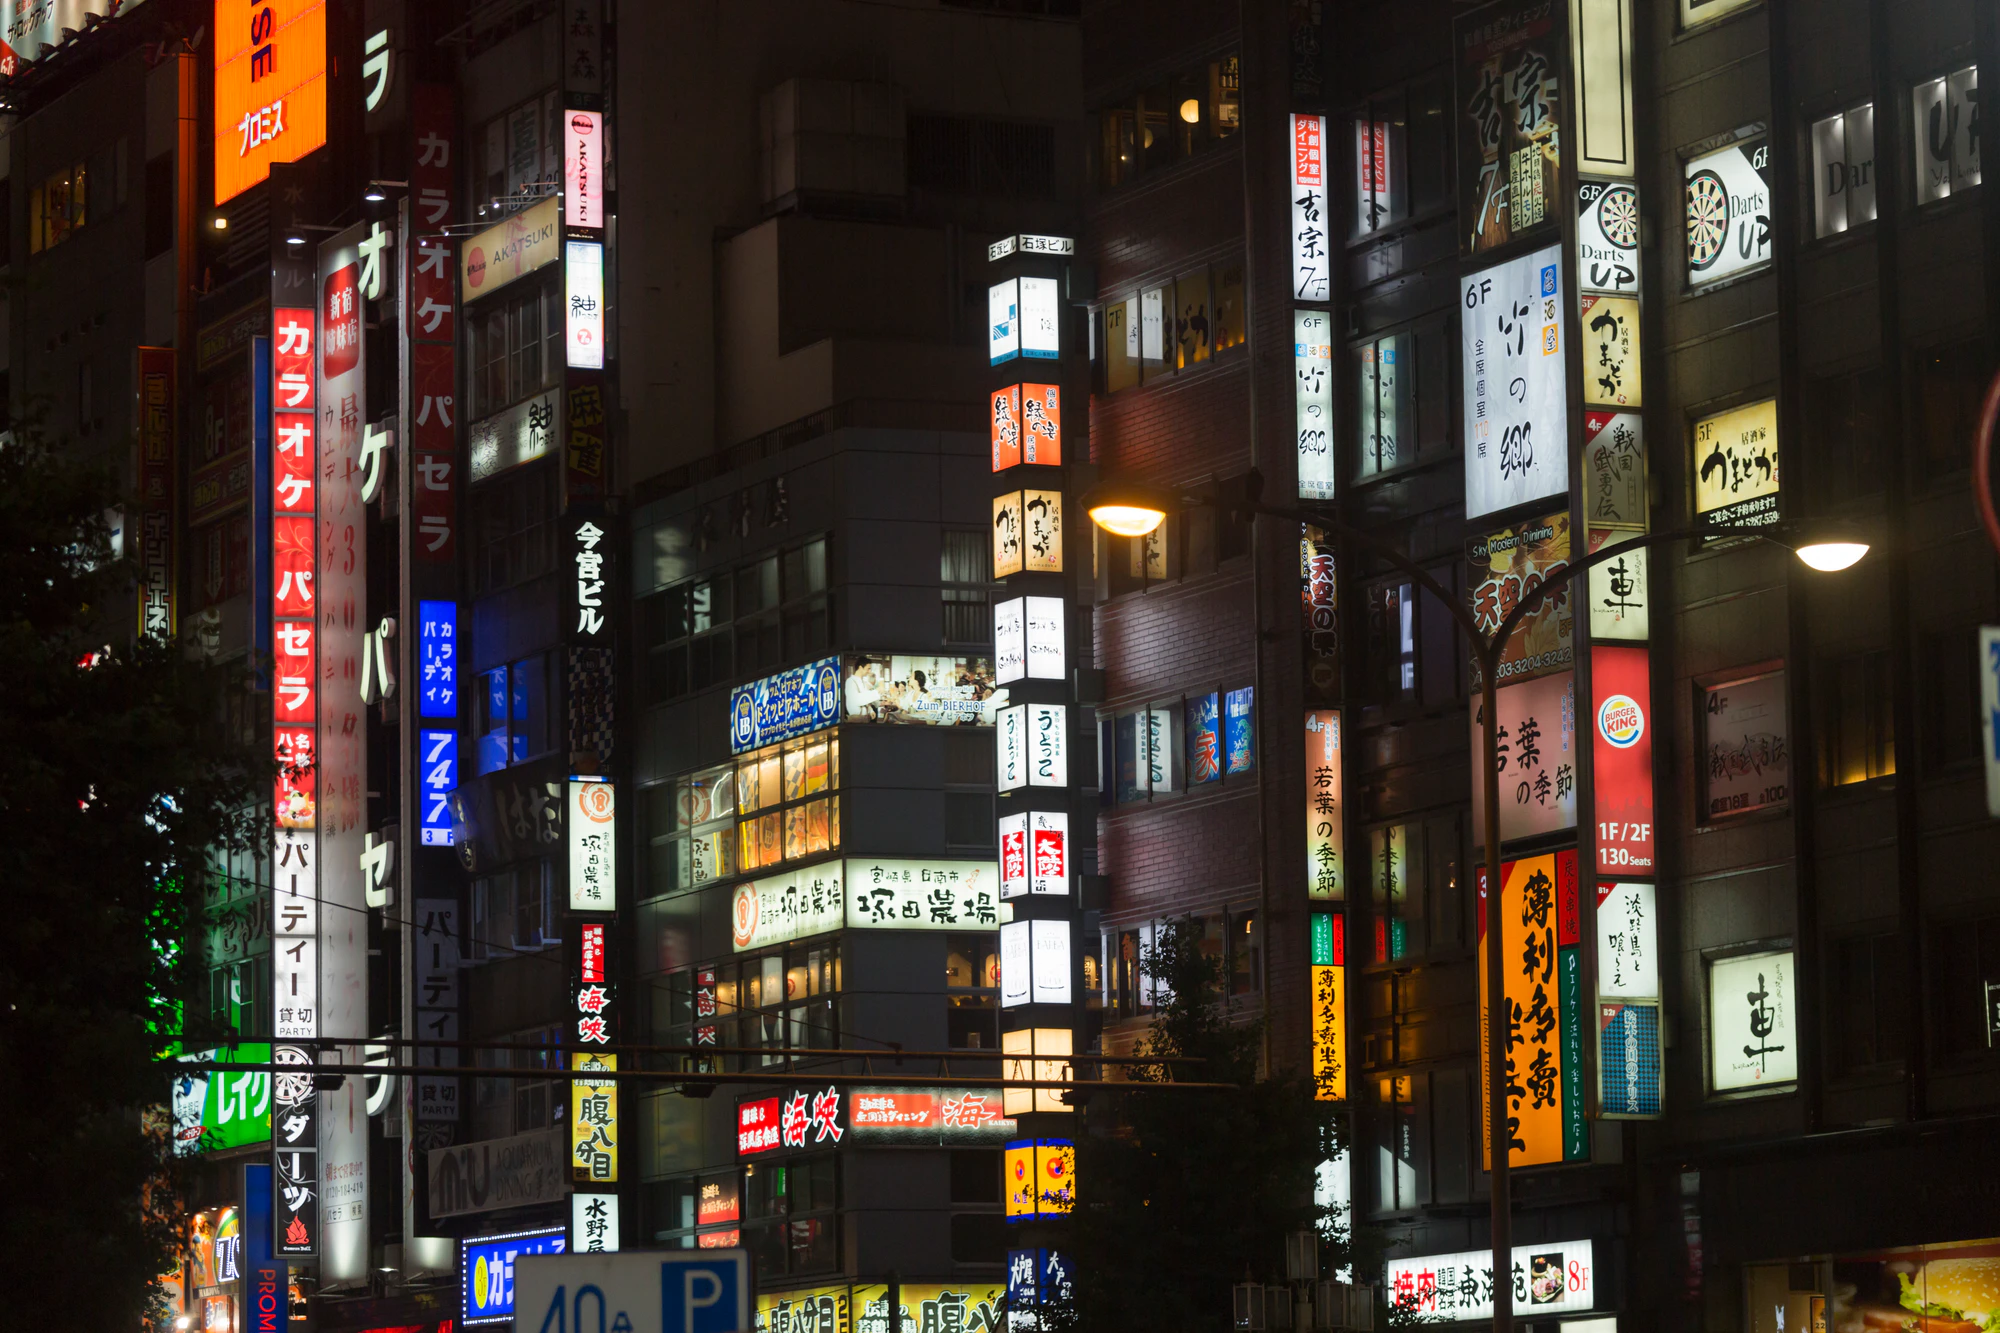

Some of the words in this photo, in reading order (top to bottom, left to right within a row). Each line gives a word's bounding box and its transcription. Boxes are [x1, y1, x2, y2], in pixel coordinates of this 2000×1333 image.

[251, 0, 272, 83] SE
[1468, 51, 1549, 148] 吉宗
[238, 100, 284, 157] プロミス
[1297, 119, 1308, 174] ダイニング
[1308, 119, 1320, 175] 和創個室
[1521, 152, 1532, 226] 牛ホルモン
[1579, 184, 1602, 201] 6F
[1731, 190, 1763, 218] Darts
[416, 131, 451, 333] カラオケ
[493, 223, 554, 265] AKATSUKI
[1022, 236, 1072, 252] 石塚ビル
[1295, 189, 1325, 260] 吉宗
[989, 235, 1017, 261] 石塚ビル
[1581, 243, 1625, 262] Darts
[1298, 266, 1328, 298] 7F
[1465, 278, 1492, 309] 6F
[1589, 262, 1636, 291] UP
[329, 286, 353, 321] 新宿
[1109, 308, 1123, 329] 7F
[1303, 317, 1322, 328] 6F
[1581, 298, 1594, 309] 5F
[1589, 308, 1624, 399] かまどか
[276, 321, 311, 508] カラオケ
[1587, 418, 1602, 432] 4F
[1698, 422, 1714, 443] 5F
[1612, 422, 1642, 472] 戦国
[1741, 426, 1767, 447] 居酒家
[416, 394, 452, 552] パセラ
[1593, 444, 1621, 520] 武勇伝
[1700, 441, 1778, 493] かまどか
[996, 503, 1021, 559] かまどか
[1026, 494, 1052, 559] かまどか
[1472, 545, 1488, 558] Sky
[1490, 536, 1520, 553] Modern
[1591, 533, 1603, 544] 3F
[575, 521, 605, 635] 今宮ビル
[1603, 556, 1643, 618] 車
[276, 570, 312, 711] パセラ
[423, 620, 437, 702] パーティ
[434, 655, 443, 668] &
[440, 620, 453, 704] カラオケ
[757, 690, 815, 723] ドイツビアホール
[917, 699, 939, 711] Zum
[943, 700, 986, 712] BIERHOF
[1305, 713, 1325, 734] 4F
[1604, 706, 1636, 723] BURGER
[1707, 691, 1728, 716] 4F
[1606, 715, 1638, 735] KING
[426, 732, 452, 823] 747
[1516, 763, 1572, 807] の季節
[425, 830, 434, 843] 3
[1313, 764, 1337, 894] 若葉の季節
[871, 865, 912, 883] 宮崎県
[922, 868, 959, 883] 日南市
[1599, 847, 1629, 866] 130
[1629, 855, 1652, 867] Seats
[280, 842, 309, 997] パーティー
[780, 878, 842, 923] 塚田農場
[857, 887, 996, 925] 塚田農場
[279, 1007, 313, 1024] 貸切
[279, 1027, 313, 1036] PARTY
[577, 984, 611, 1045] 海峡
[1742, 972, 1785, 1073] 車
[1623, 1009, 1639, 1113] 絵本の国のアリス
[421, 1084, 456, 1102] 貸切
[422, 1105, 456, 1115] PARTY
[575, 1092, 617, 1179] 腹八分目
[782, 1085, 845, 1148] 海峡
[282, 1113, 311, 1213] ダーツ
[1568, 1259, 1589, 1292] 8F
[684, 1270, 723, 1333] P
